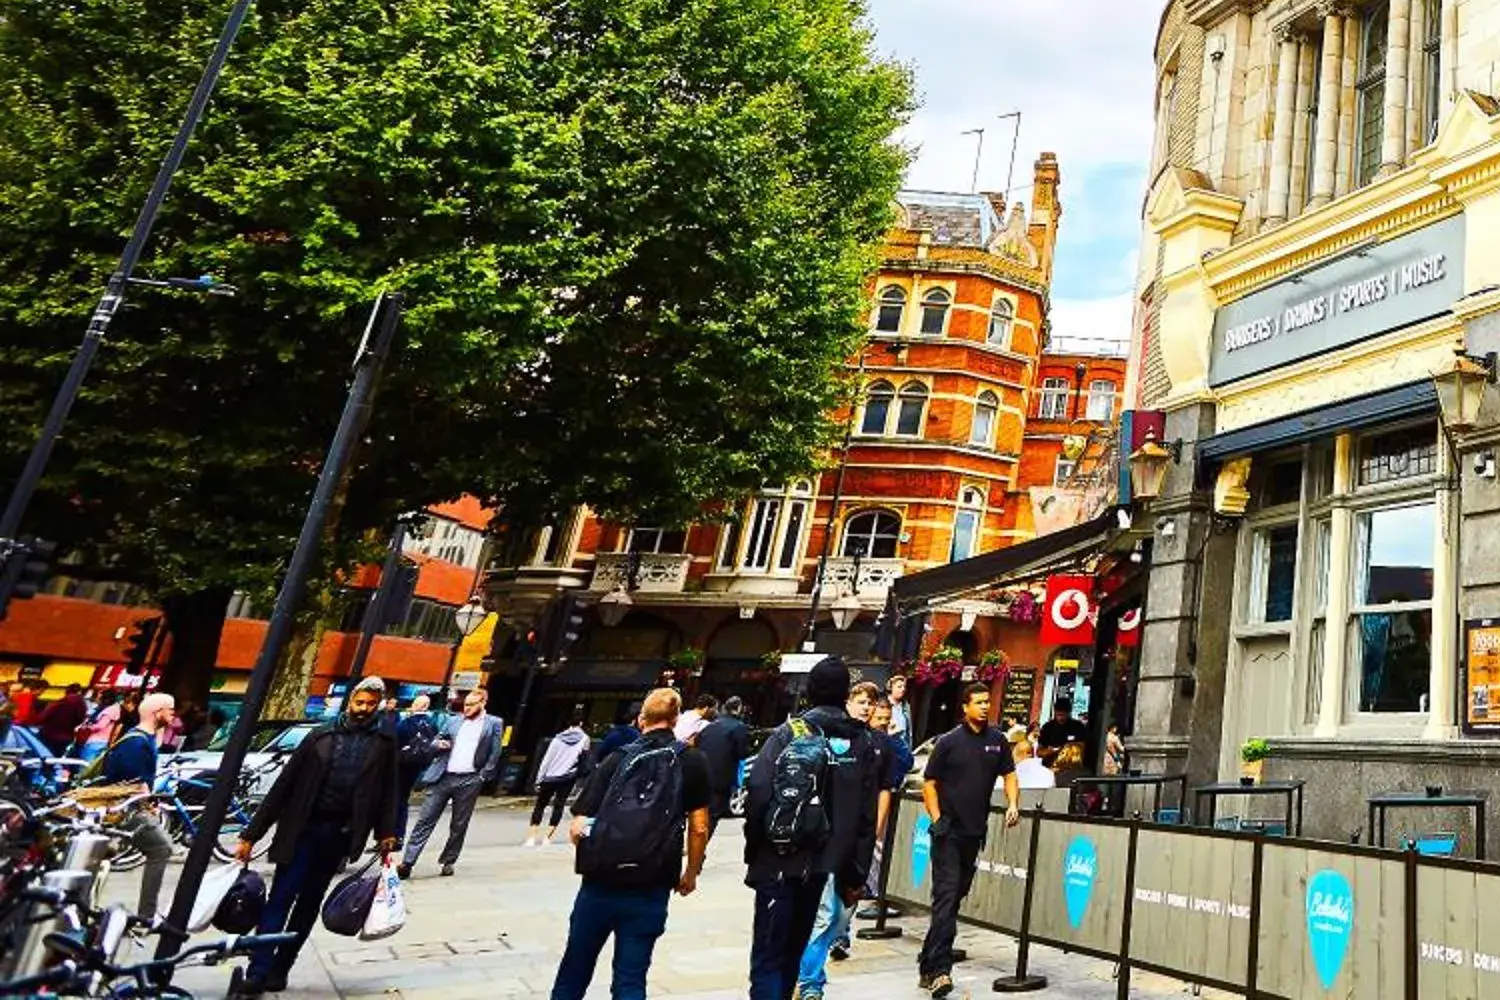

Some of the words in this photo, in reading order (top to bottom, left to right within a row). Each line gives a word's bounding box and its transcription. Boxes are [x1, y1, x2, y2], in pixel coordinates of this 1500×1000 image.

[1225, 316, 1272, 351] BURGERS
[1339, 272, 1388, 313] SPORTS
[1401, 253, 1448, 292] MUSIC
